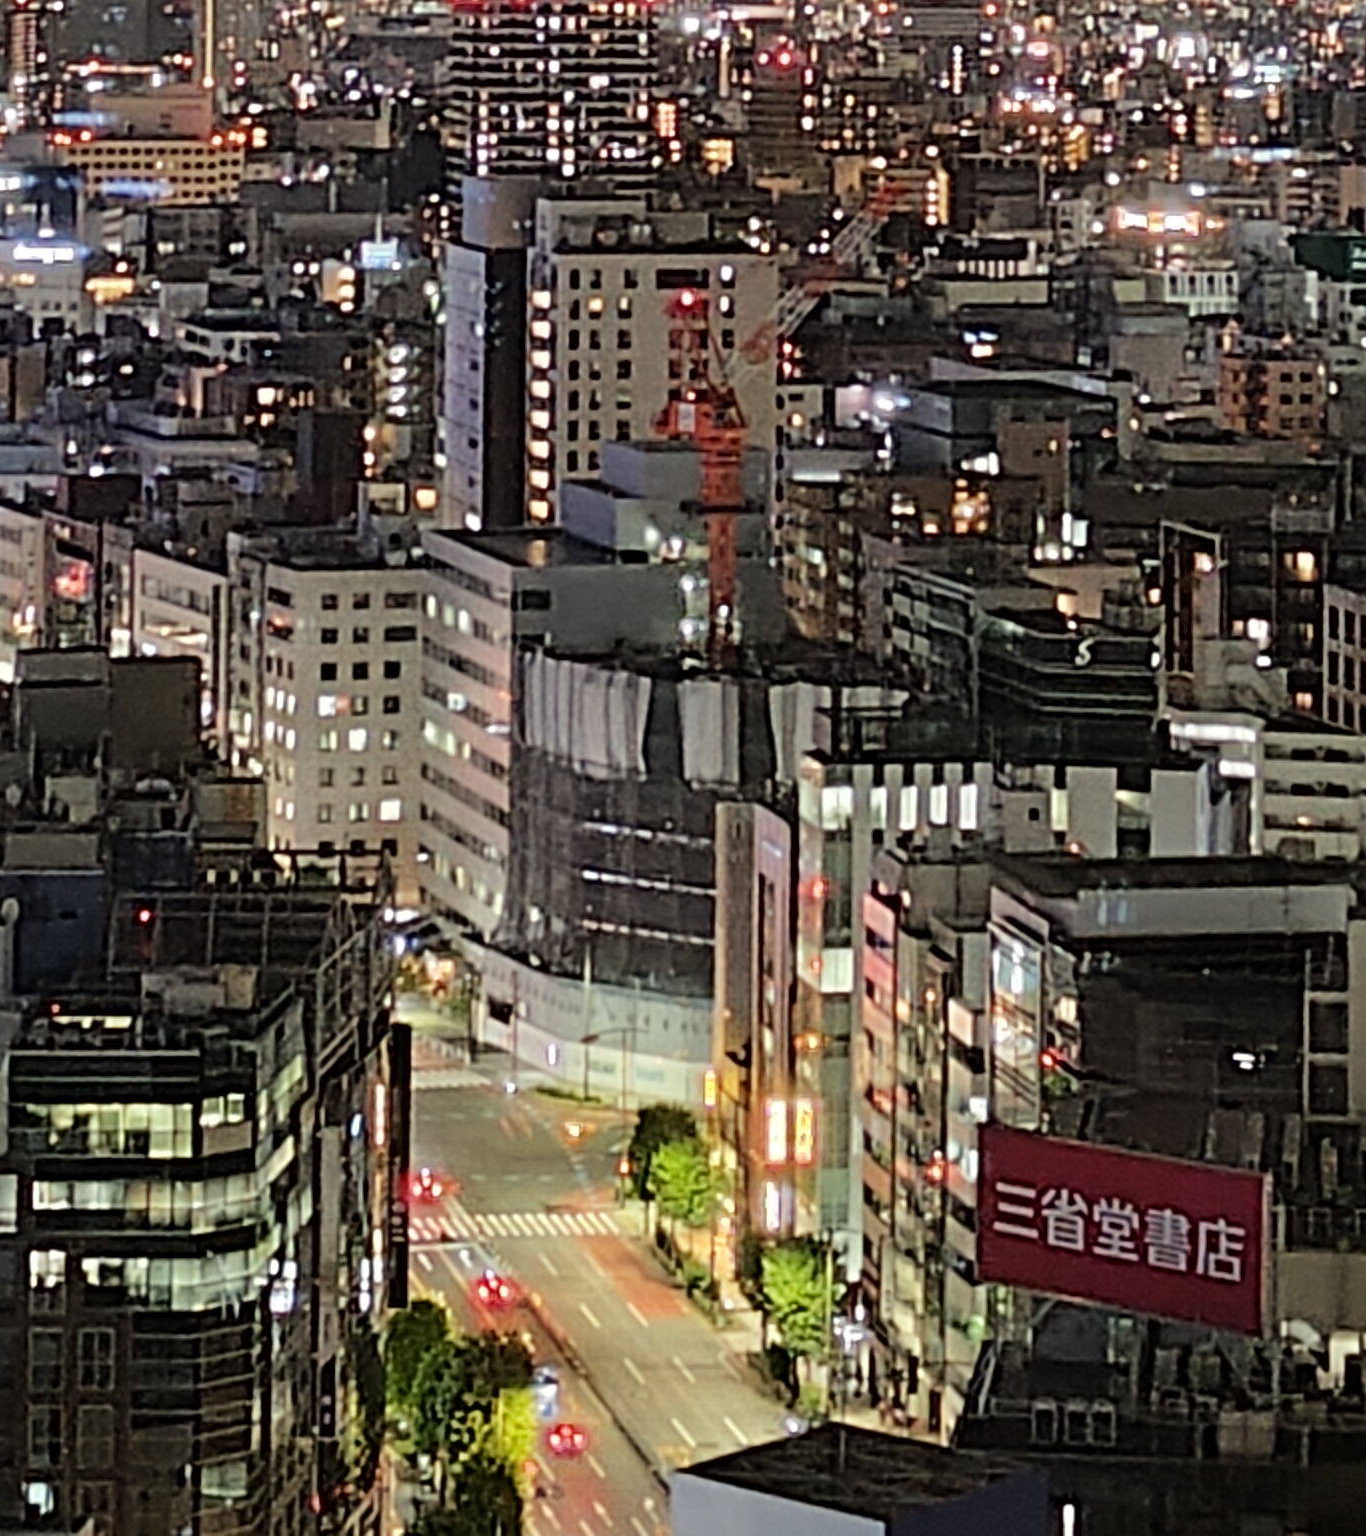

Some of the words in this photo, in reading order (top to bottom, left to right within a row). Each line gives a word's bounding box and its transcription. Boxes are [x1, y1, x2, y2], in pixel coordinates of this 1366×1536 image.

[992, 1180, 1246, 1283] 三省堂書店
